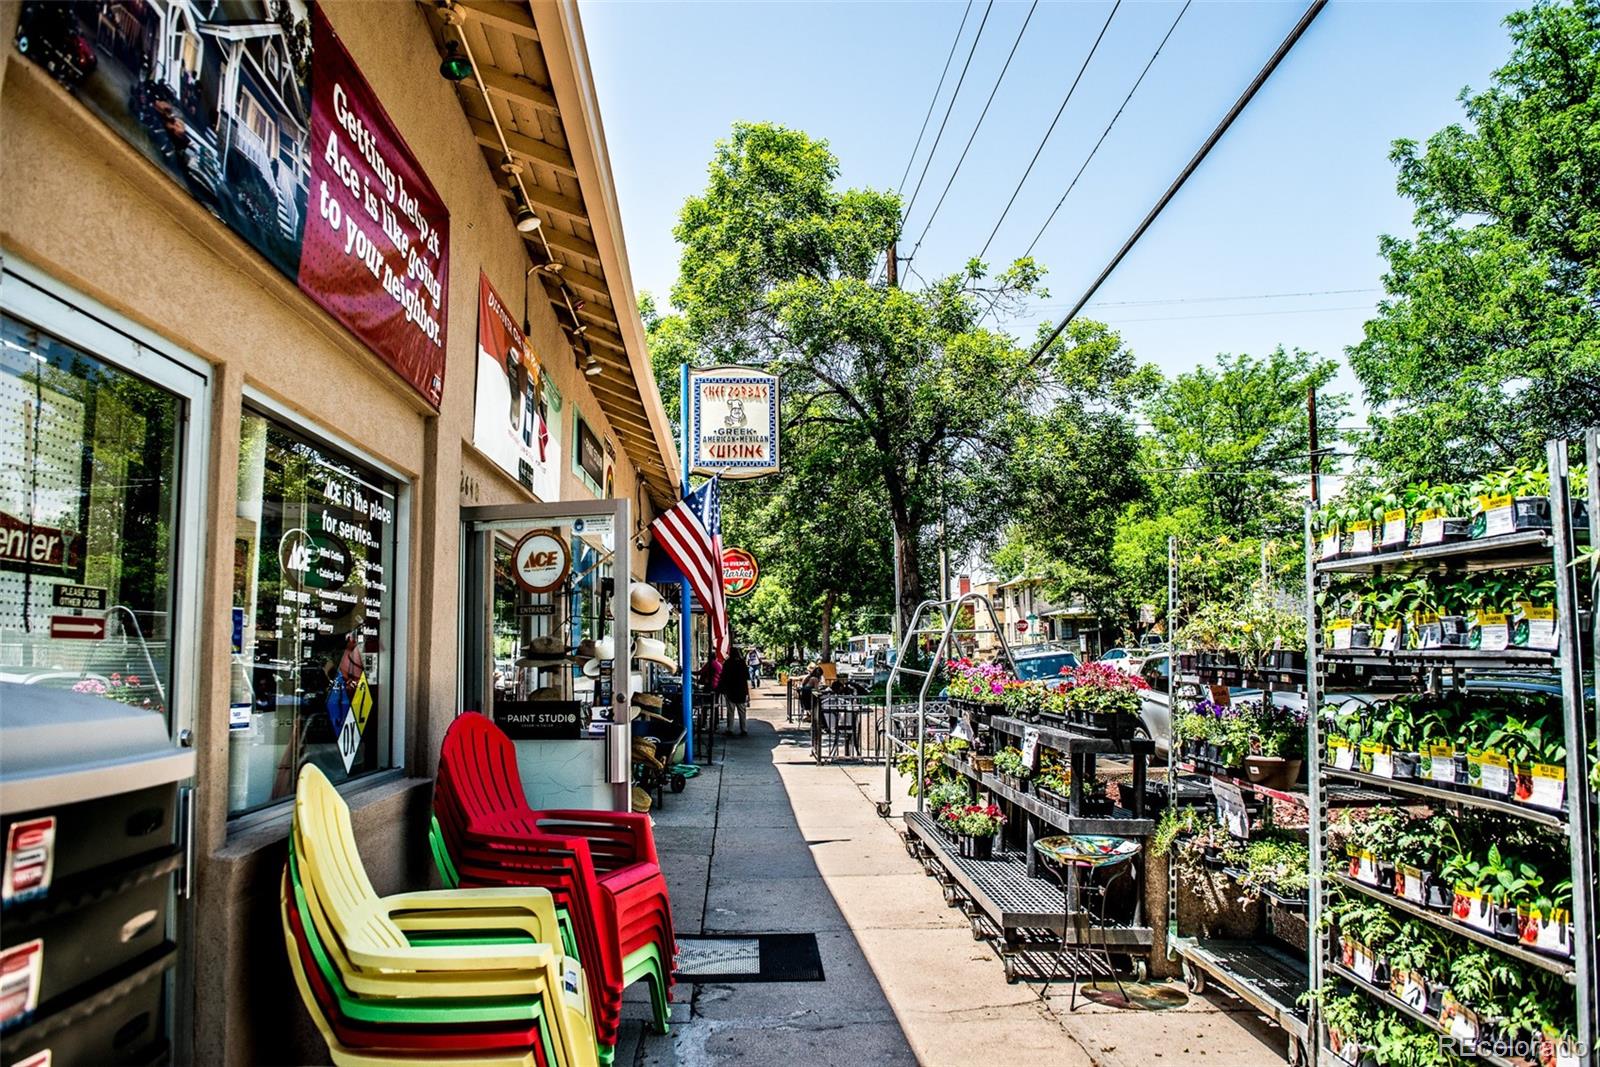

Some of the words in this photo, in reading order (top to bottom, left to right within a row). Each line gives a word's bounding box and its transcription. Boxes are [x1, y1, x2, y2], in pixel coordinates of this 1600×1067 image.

[333, 83, 396, 203] Getting
[398, 174, 428, 243] help
[427, 228, 440, 259] at
[324, 130, 360, 198] Ace
[364, 177, 379, 222] is
[382, 202, 409, 259] like
[408, 249, 441, 309] going
[319, 180, 341, 230] to
[344, 214, 384, 280] your
[382, 265, 442, 347] neighbor.
[703, 386, 724, 397] CHEF
[709, 445, 764, 458] CUISINE
[323, 476, 341, 501] ACE
[343, 485, 351, 507] is
[354, 488, 368, 514] the
[369, 500, 391, 524] place
[322, 510, 337, 533] for
[339, 521, 379, 548] service...
[287, 540, 311, 572] ACE
[523, 551, 558, 569] ACE
[59, 597, 81, 607] OTHER
[82, 598, 100, 608] DOOR
[60, 586, 86, 598] PLEASE
[359, 682, 365, 723] 2
[507, 714, 536, 723] PAINT
[538, 714, 577, 723] STUDIO
[343, 721, 355, 757] OX
